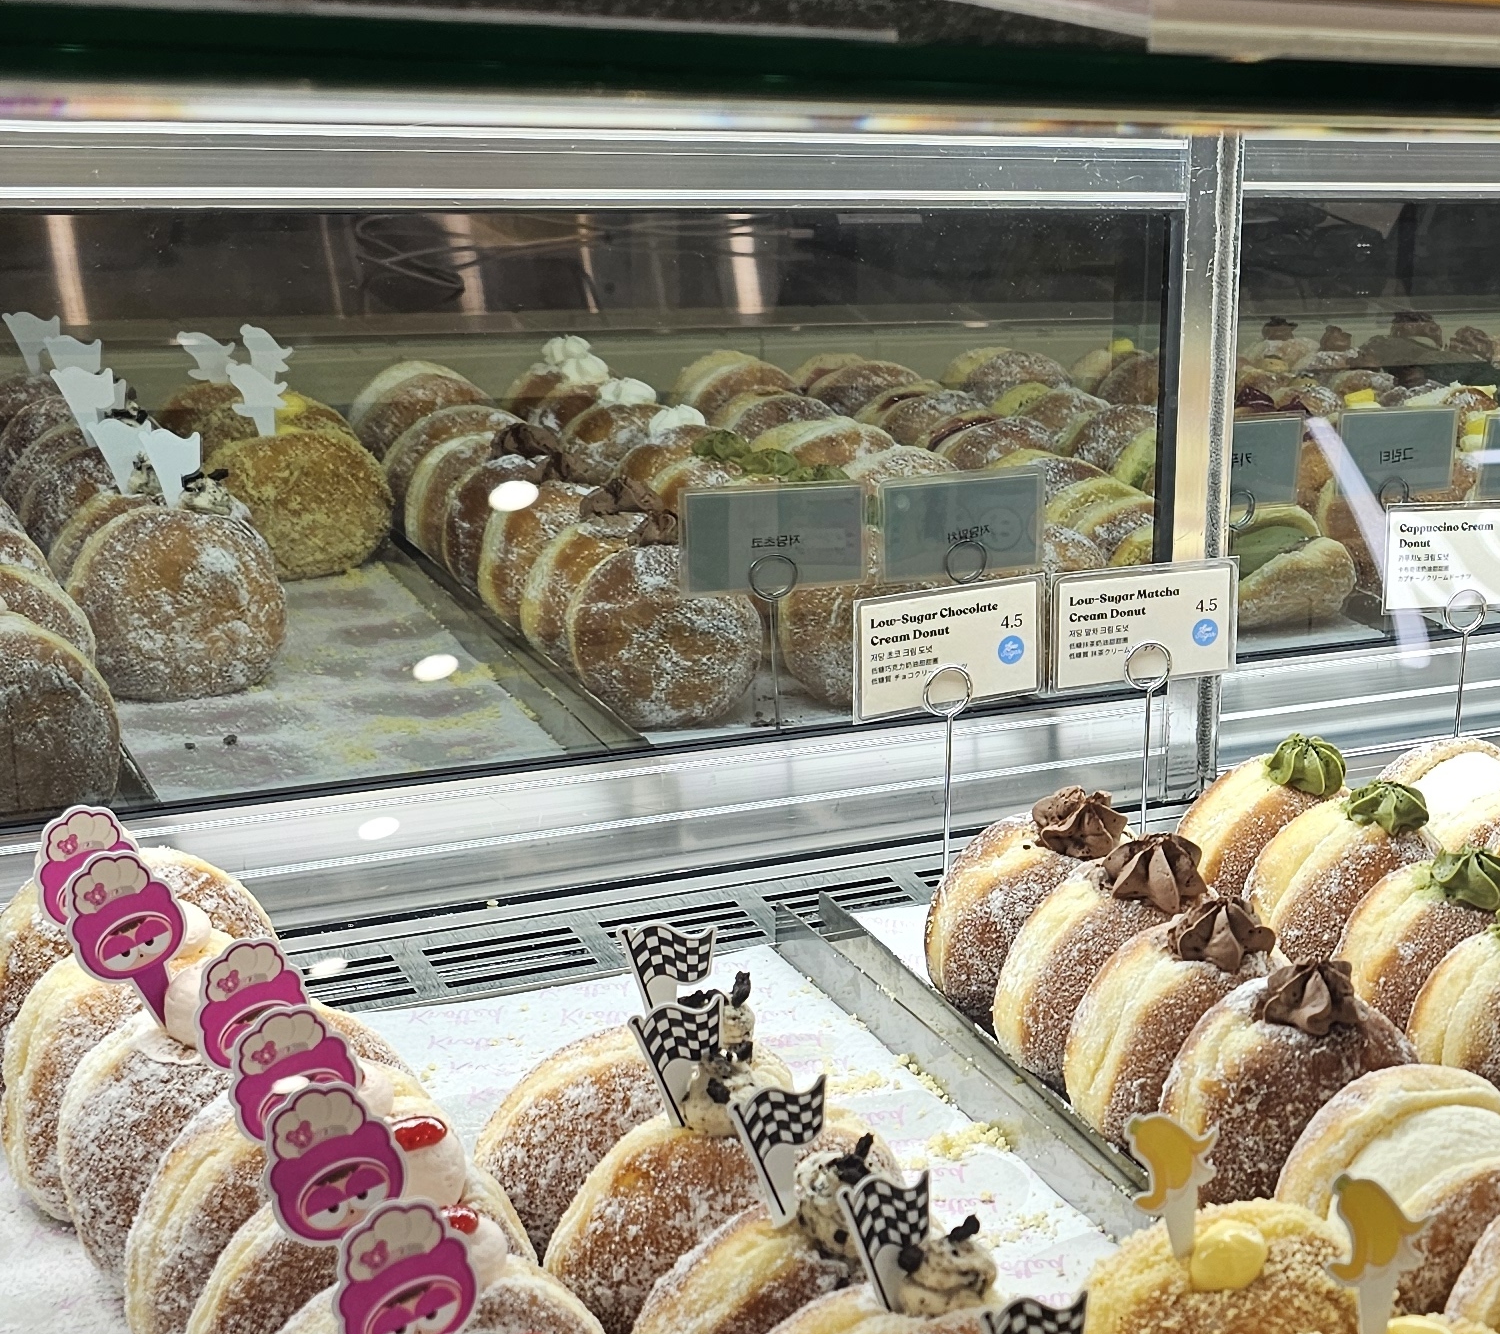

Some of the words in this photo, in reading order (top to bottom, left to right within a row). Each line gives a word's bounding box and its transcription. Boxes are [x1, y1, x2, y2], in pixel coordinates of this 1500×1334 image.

[1399, 522, 1460, 535] Cappuccino
[1461, 522, 1494, 532] Cream
[1399, 539, 1431, 549] Donut
[1069, 592, 1136, 607] Low-Sugar
[1136, 587, 1180, 600] Matcha
[1195, 598, 1218, 613] 4.5
[870, 610, 939, 630] Low-Sugar
[939, 602, 999, 619] Chocolate
[1000, 613, 1024, 630] 4.5
[1069, 612, 1108, 623] Cream
[1110, 607, 1147, 619] Donut
[870, 632, 911, 647] Cream
[912, 626, 950, 641] Donut
[1068, 629, 1083, 638] 저당
[1084, 627, 1099, 636] 말차
[1100, 626, 1114, 635] 크림
[1115, 624, 1130, 633] 도넛
[870, 653, 885, 663] 저당
[886, 650, 902, 660] 초코
[902, 647, 917, 657] 크림
[918, 644, 933, 655] 도넛
